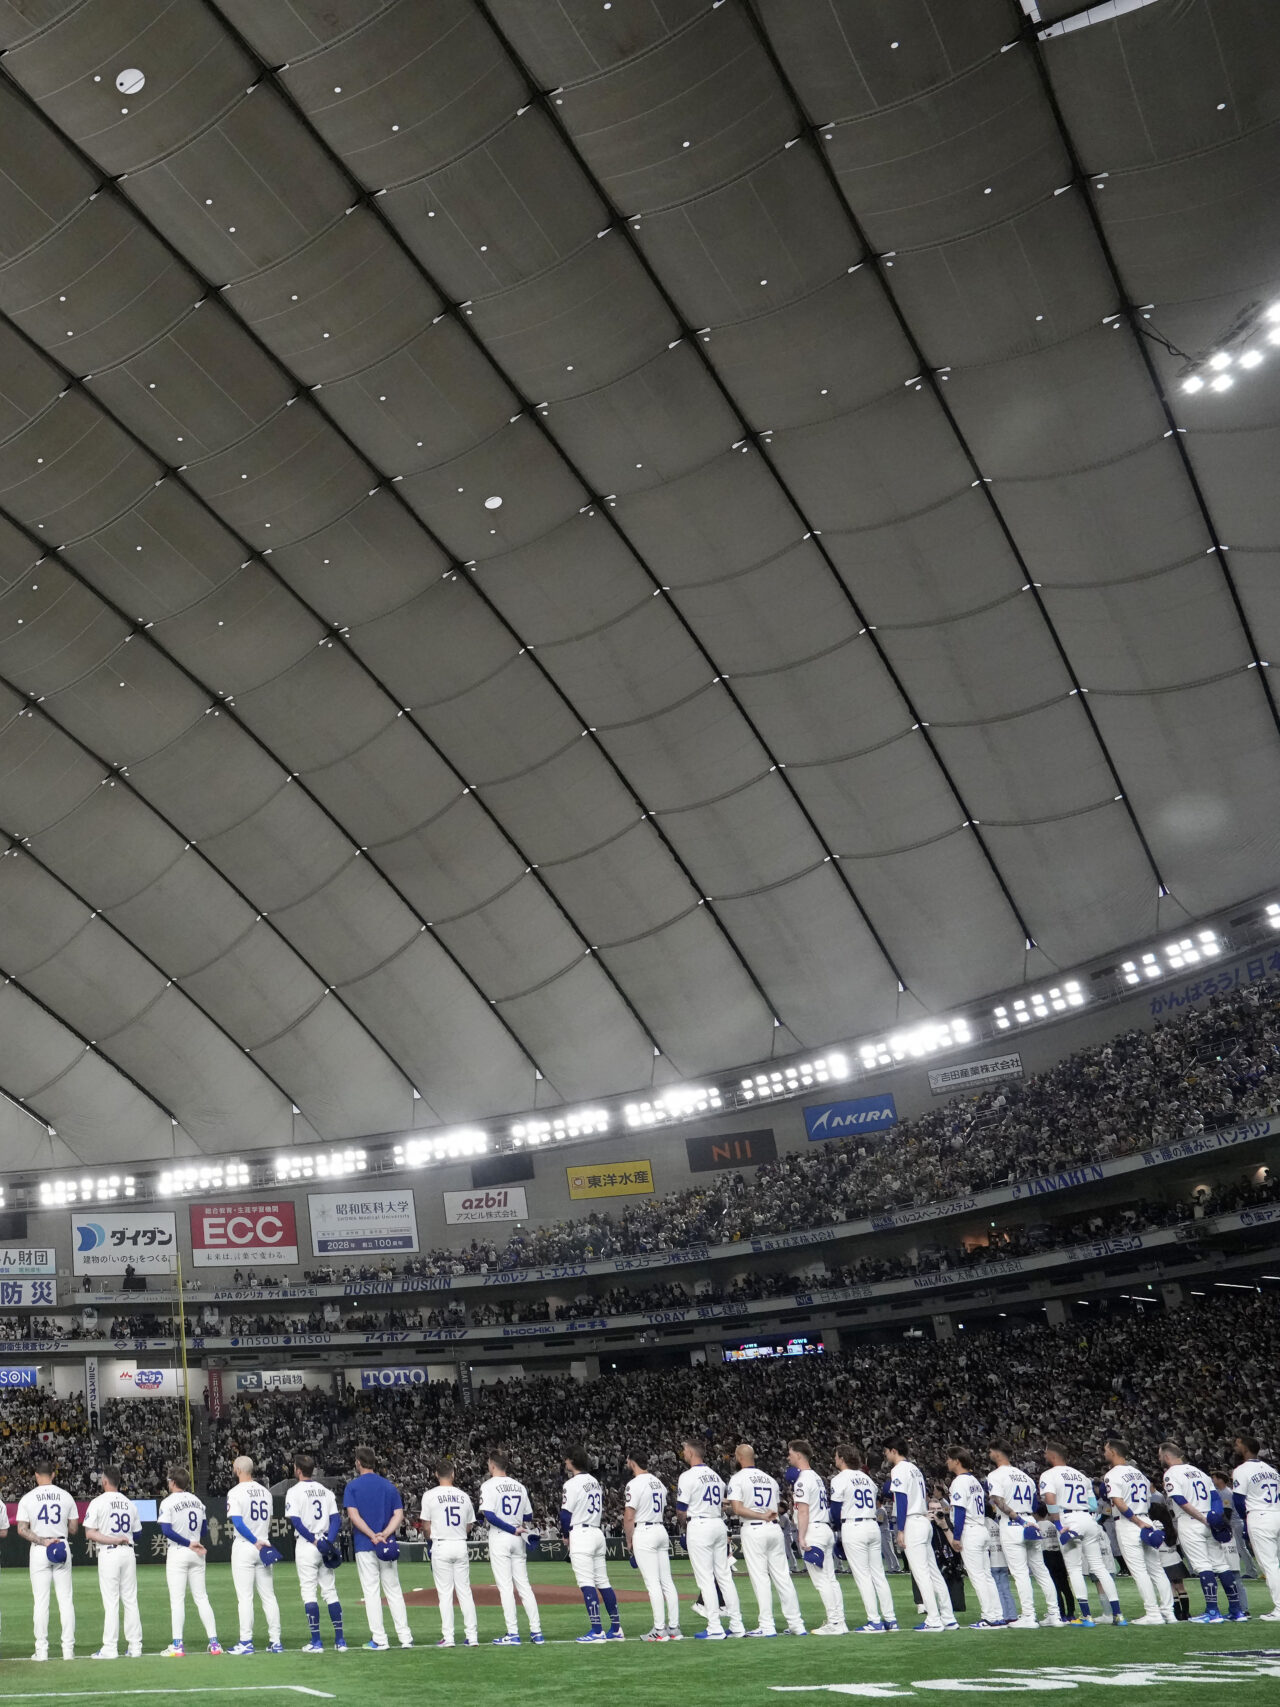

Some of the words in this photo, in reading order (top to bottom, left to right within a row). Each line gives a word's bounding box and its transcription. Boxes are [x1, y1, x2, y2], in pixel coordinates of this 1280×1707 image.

[832, 1108, 894, 1127] AKIRA
[587, 1170, 650, 1189] 東洋水産
[336, 1201, 409, 1215] 昭和医科大学
[461, 1191, 508, 1211] azbil
[456, 1209, 518, 1222] アズビル株式会社
[110, 1227, 173, 1247] ダイダン
[202, 1215, 284, 1245] ECC
[241, 1375, 258, 1385] JR
[264, 1373, 303, 1386] JR貨物
[363, 1369, 426, 1387] TOTO
[851, 1477, 871, 1487] KNACK
[1060, 1472, 1083, 1482] ROJAS
[36, 1493, 61, 1502] BANDA
[246, 1489, 265, 1498] SCOTT
[304, 1488, 326, 1498] TAYLOR
[437, 1495, 465, 1504] BARNES
[703, 1485, 721, 1506] 49
[753, 1486, 772, 1507] 57
[854, 1488, 874, 1509] 96
[1013, 1485, 1032, 1505] 44
[1064, 1483, 1087, 1504] 72
[1130, 1483, 1148, 1503] 23
[1192, 1480, 1208, 1501] 13
[1261, 1483, 1279, 1503] 37
[110, 1502, 129, 1511] YATES
[250, 1500, 269, 1521] 66
[312, 1499, 323, 1520] 3
[501, 1495, 522, 1516] 67
[587, 1493, 601, 1514] 33
[652, 1492, 663, 1513] 51
[974, 1495, 984, 1515] 18
[37, 1504, 61, 1525] 43
[110, 1512, 131, 1533] 38
[188, 1511, 198, 1531] 8
[444, 1506, 461, 1526] 15
